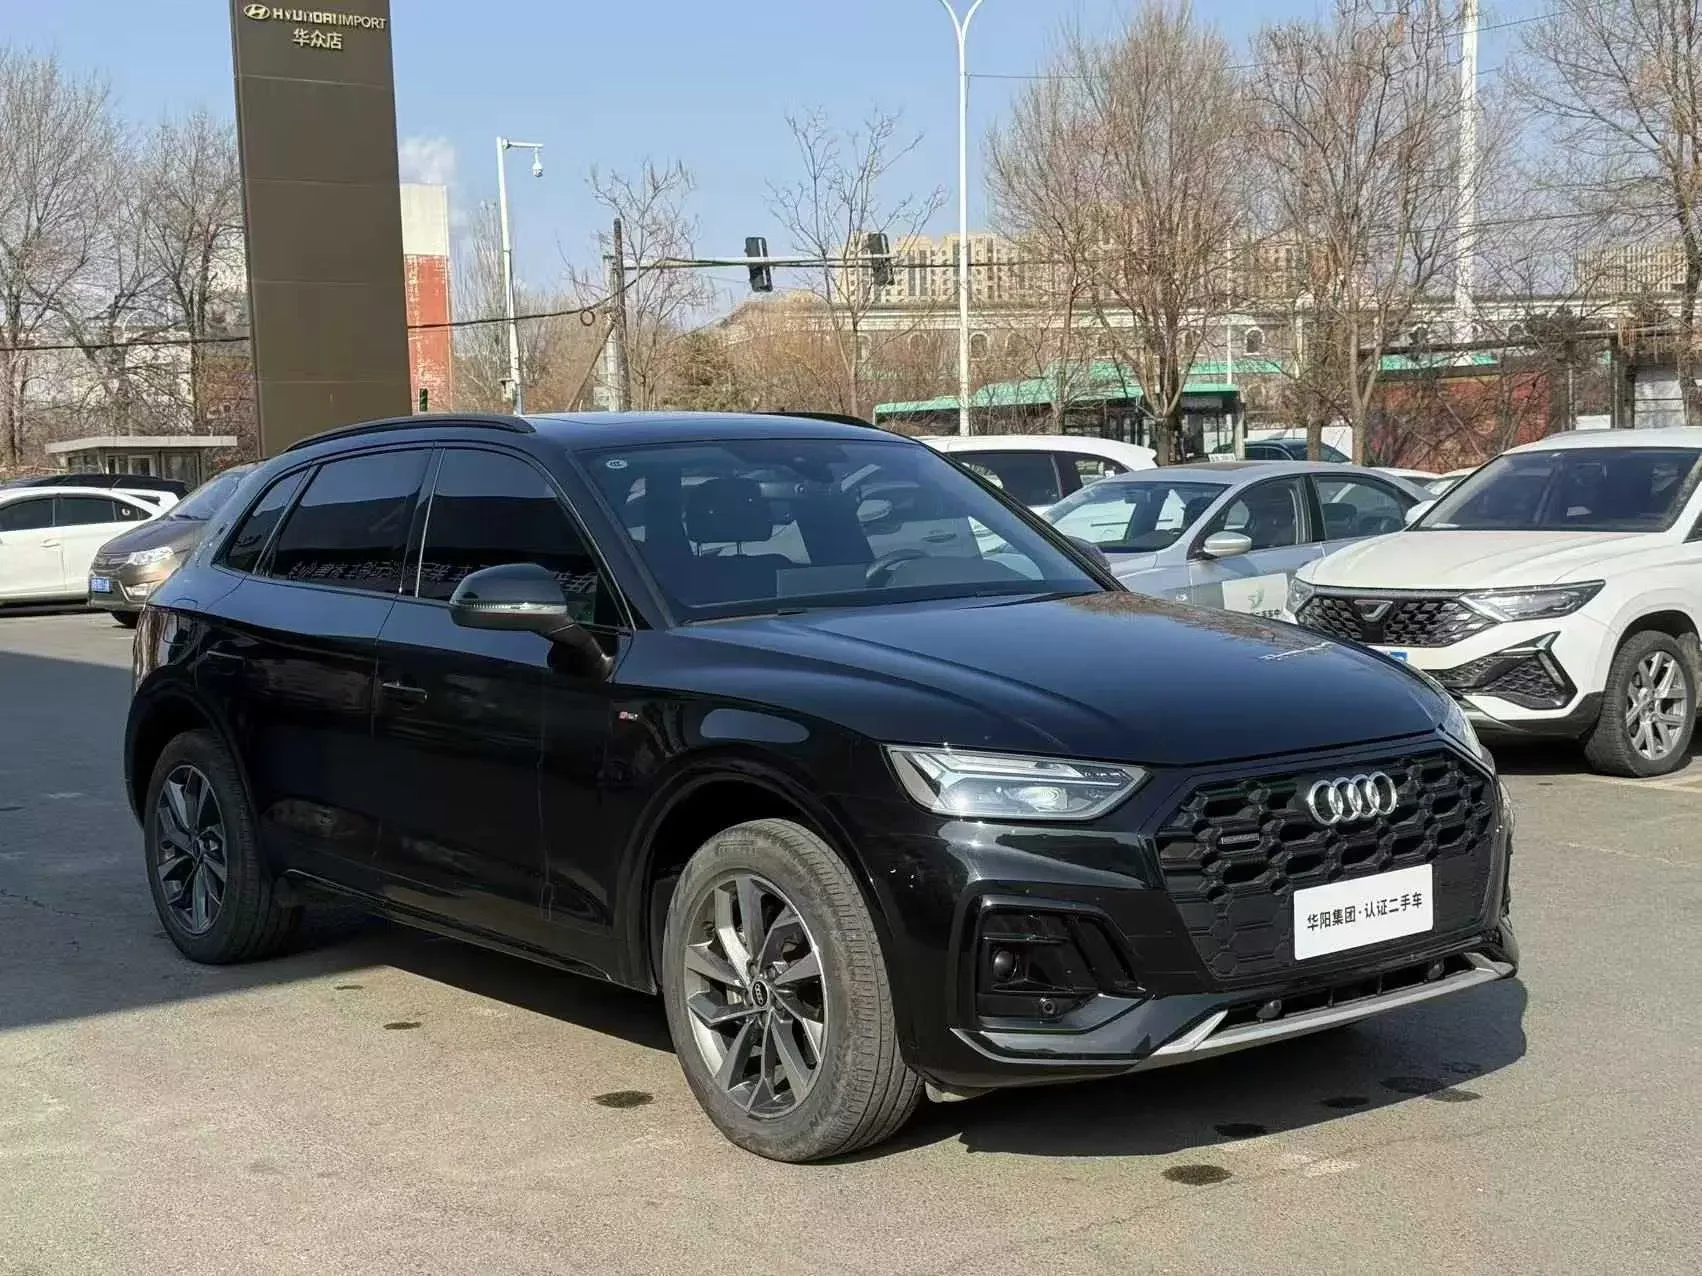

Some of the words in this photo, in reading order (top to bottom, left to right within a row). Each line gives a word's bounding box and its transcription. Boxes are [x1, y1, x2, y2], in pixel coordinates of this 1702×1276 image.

[338, 14, 387, 29] IMPORT
[293, 28, 343, 49] 华众店
